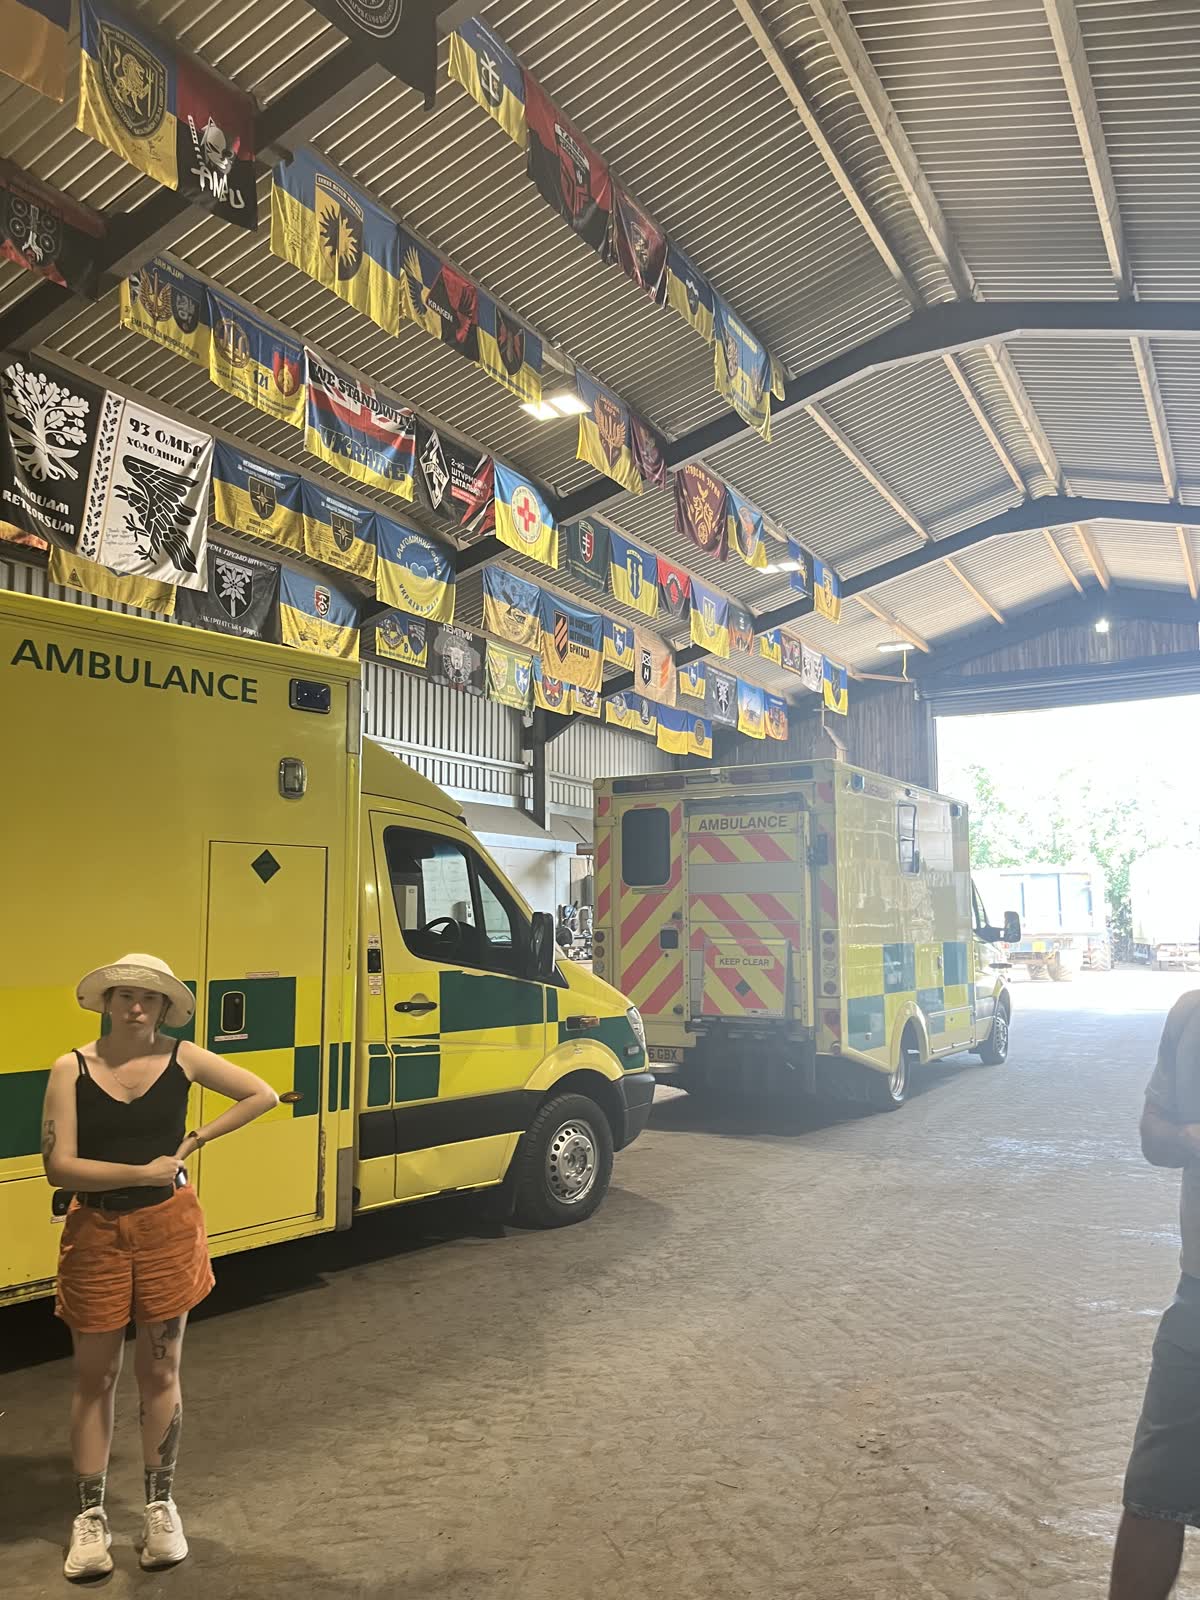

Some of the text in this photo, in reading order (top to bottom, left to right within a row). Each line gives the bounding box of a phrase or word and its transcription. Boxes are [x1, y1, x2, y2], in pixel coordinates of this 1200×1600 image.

[428, 299, 453, 323] KRAKEN
[315, 364, 336, 388] WE
[338, 378, 381, 413] STAND
[129, 417, 151, 437] 93
[320, 425, 406, 482] UKRAINE
[2, 489, 75, 535] RETRORSUM
[570, 643, 590, 659] БРИГАДА
[11, 638, 258, 704] AMBULANCE
[699, 815, 788, 831] AMBULANCE
[719, 957, 769, 967] KEEP CLEAR
[657, 1048, 677, 1061] GBX
